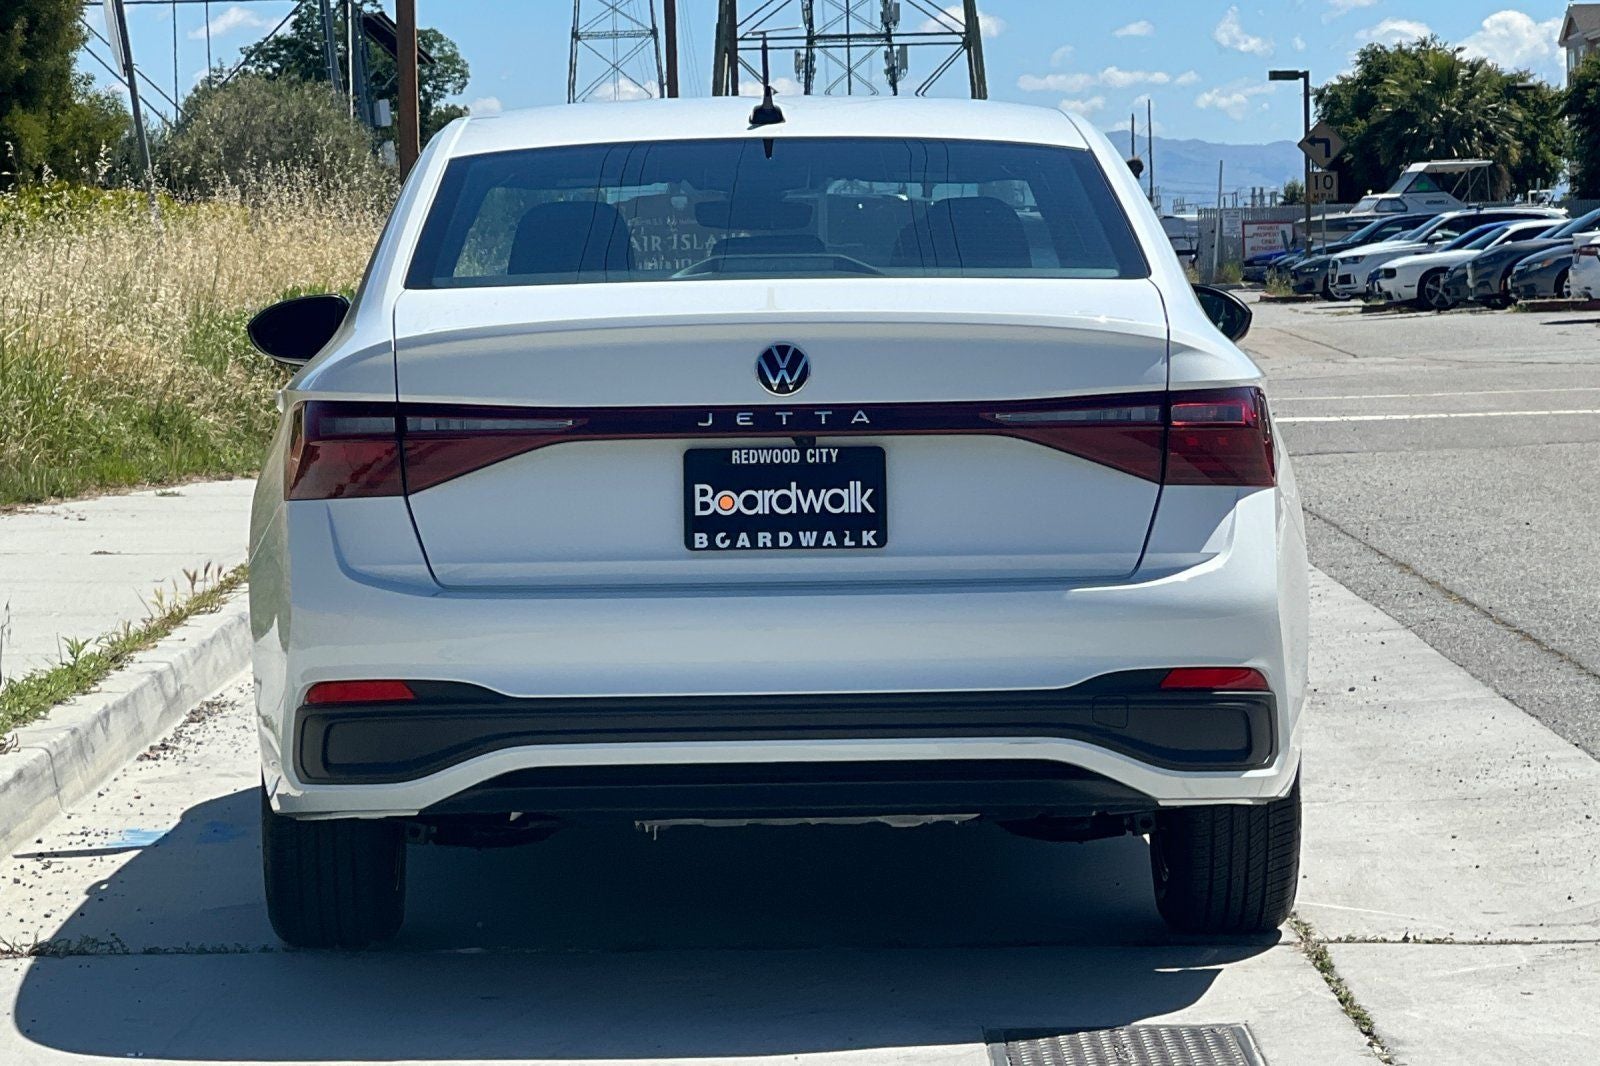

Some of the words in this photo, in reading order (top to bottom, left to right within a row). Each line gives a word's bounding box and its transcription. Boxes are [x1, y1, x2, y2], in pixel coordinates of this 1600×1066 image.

[1314, 174, 1334, 190] 10
[697, 409, 870, 427] JETTA
[731, 449, 800, 464] REDWOOD
[806, 448, 839, 463] CITY
[694, 480, 876, 516] Boardwalk
[694, 530, 878, 549] BOARDWALK
